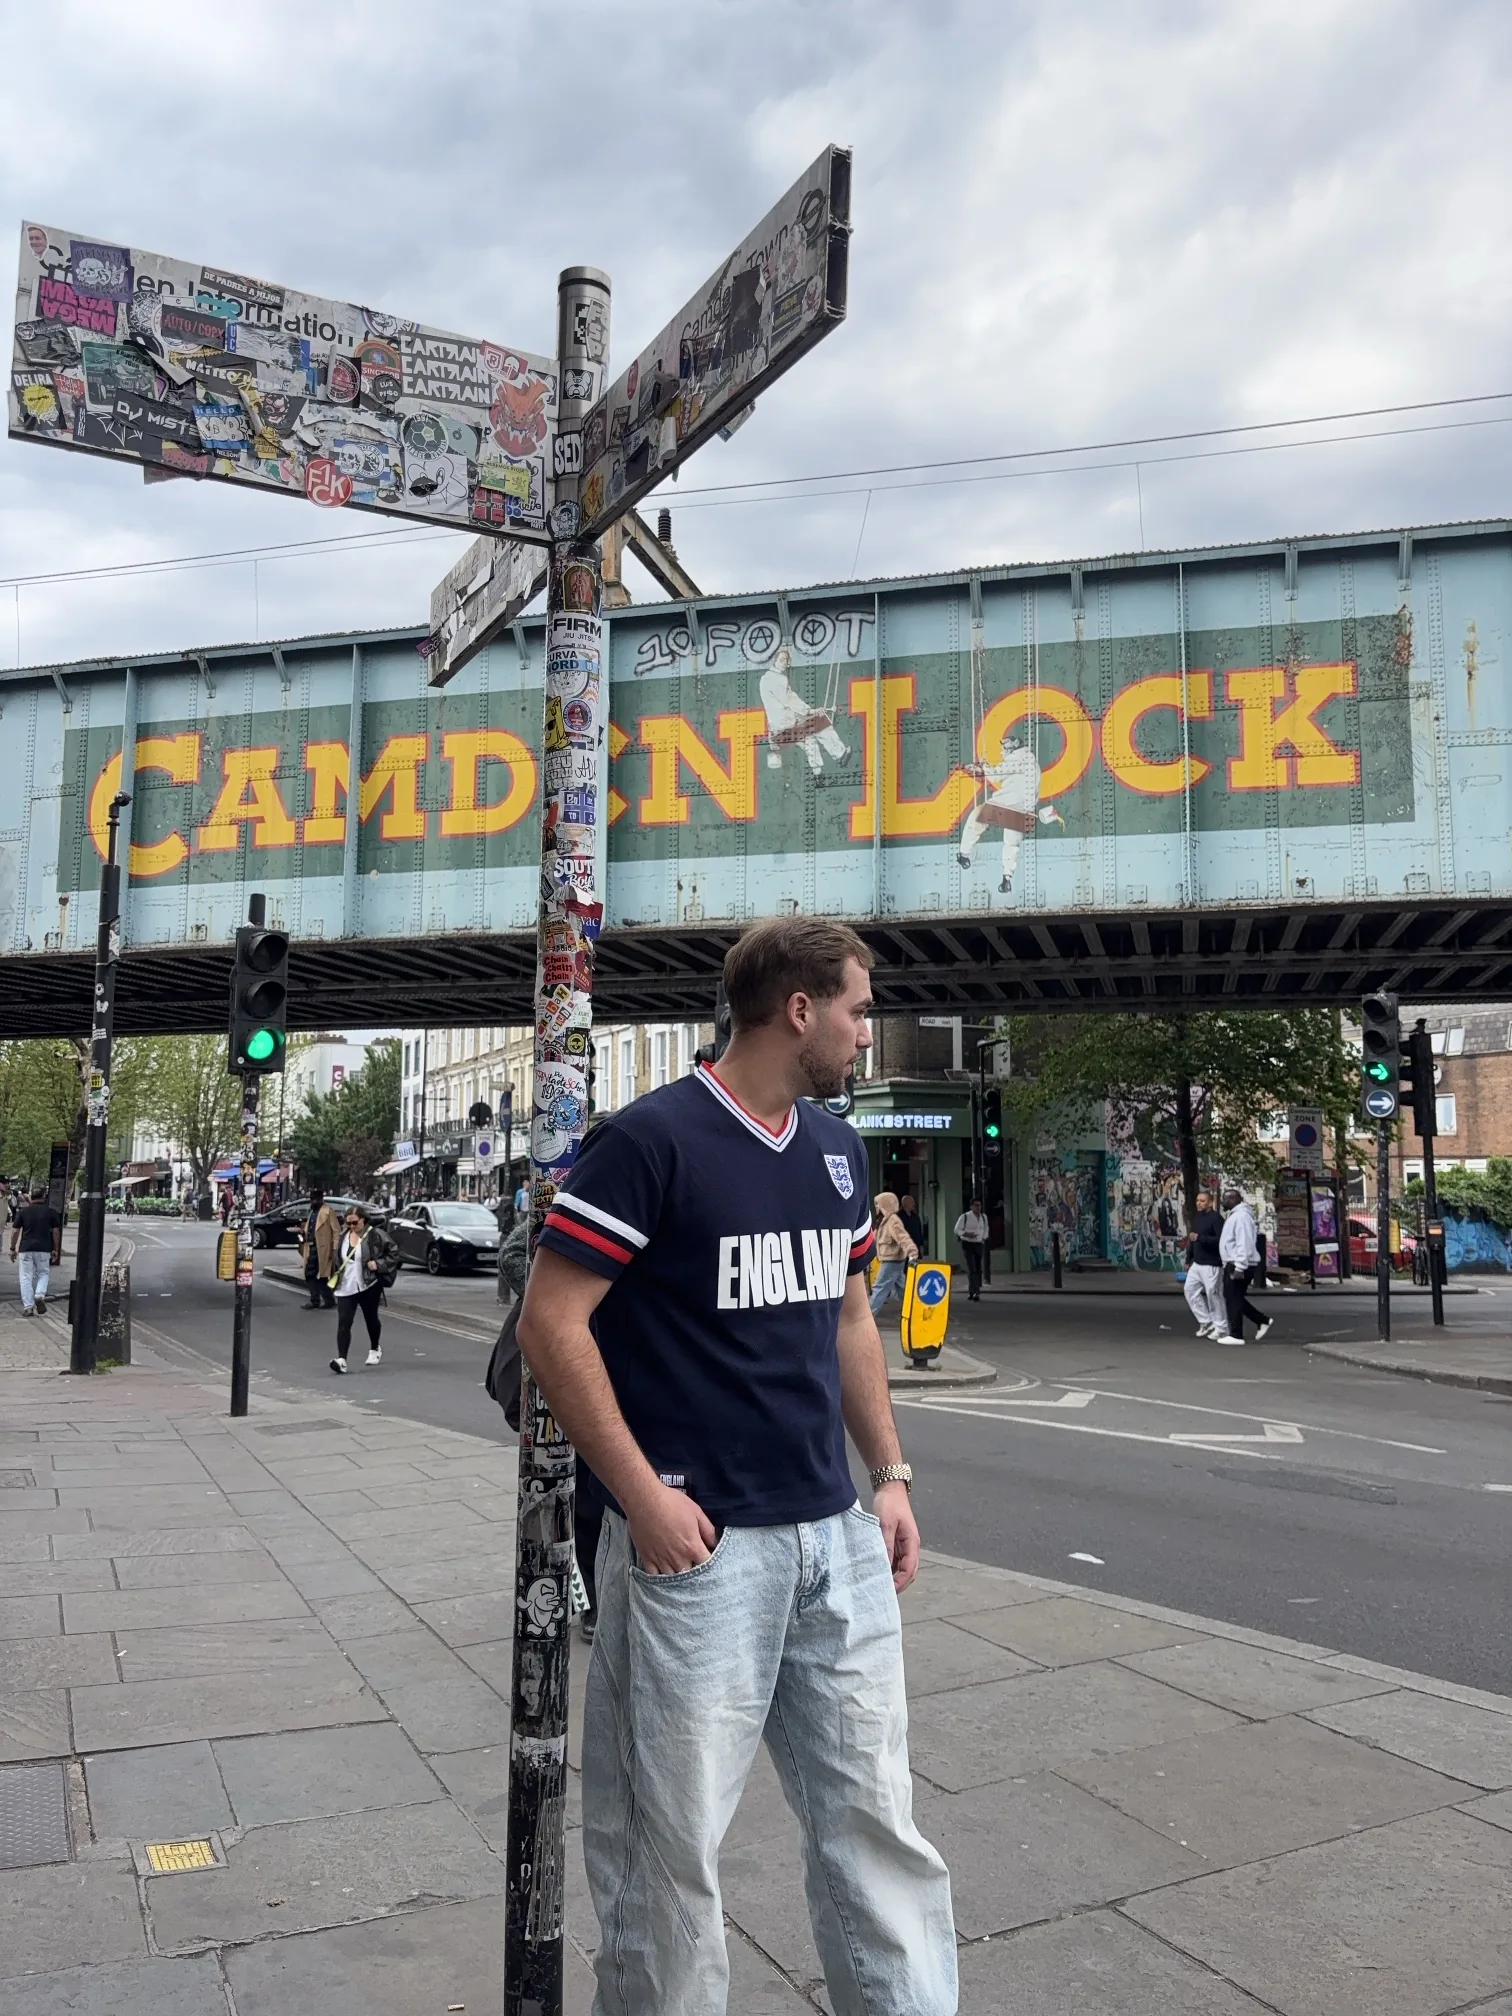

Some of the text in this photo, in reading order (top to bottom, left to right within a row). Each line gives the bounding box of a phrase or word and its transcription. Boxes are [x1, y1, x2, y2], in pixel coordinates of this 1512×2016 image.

[216, 276, 247, 294] PADRES
[117, 400, 143, 421] DJ
[553, 617, 602, 639] FIRM
[88, 659, 1360, 878] CAMDN LOCK
[893, 1114, 952, 1129] STREET
[717, 1228, 853, 1309] ENGLAND
[660, 1474, 685, 1487] ENGLAND
